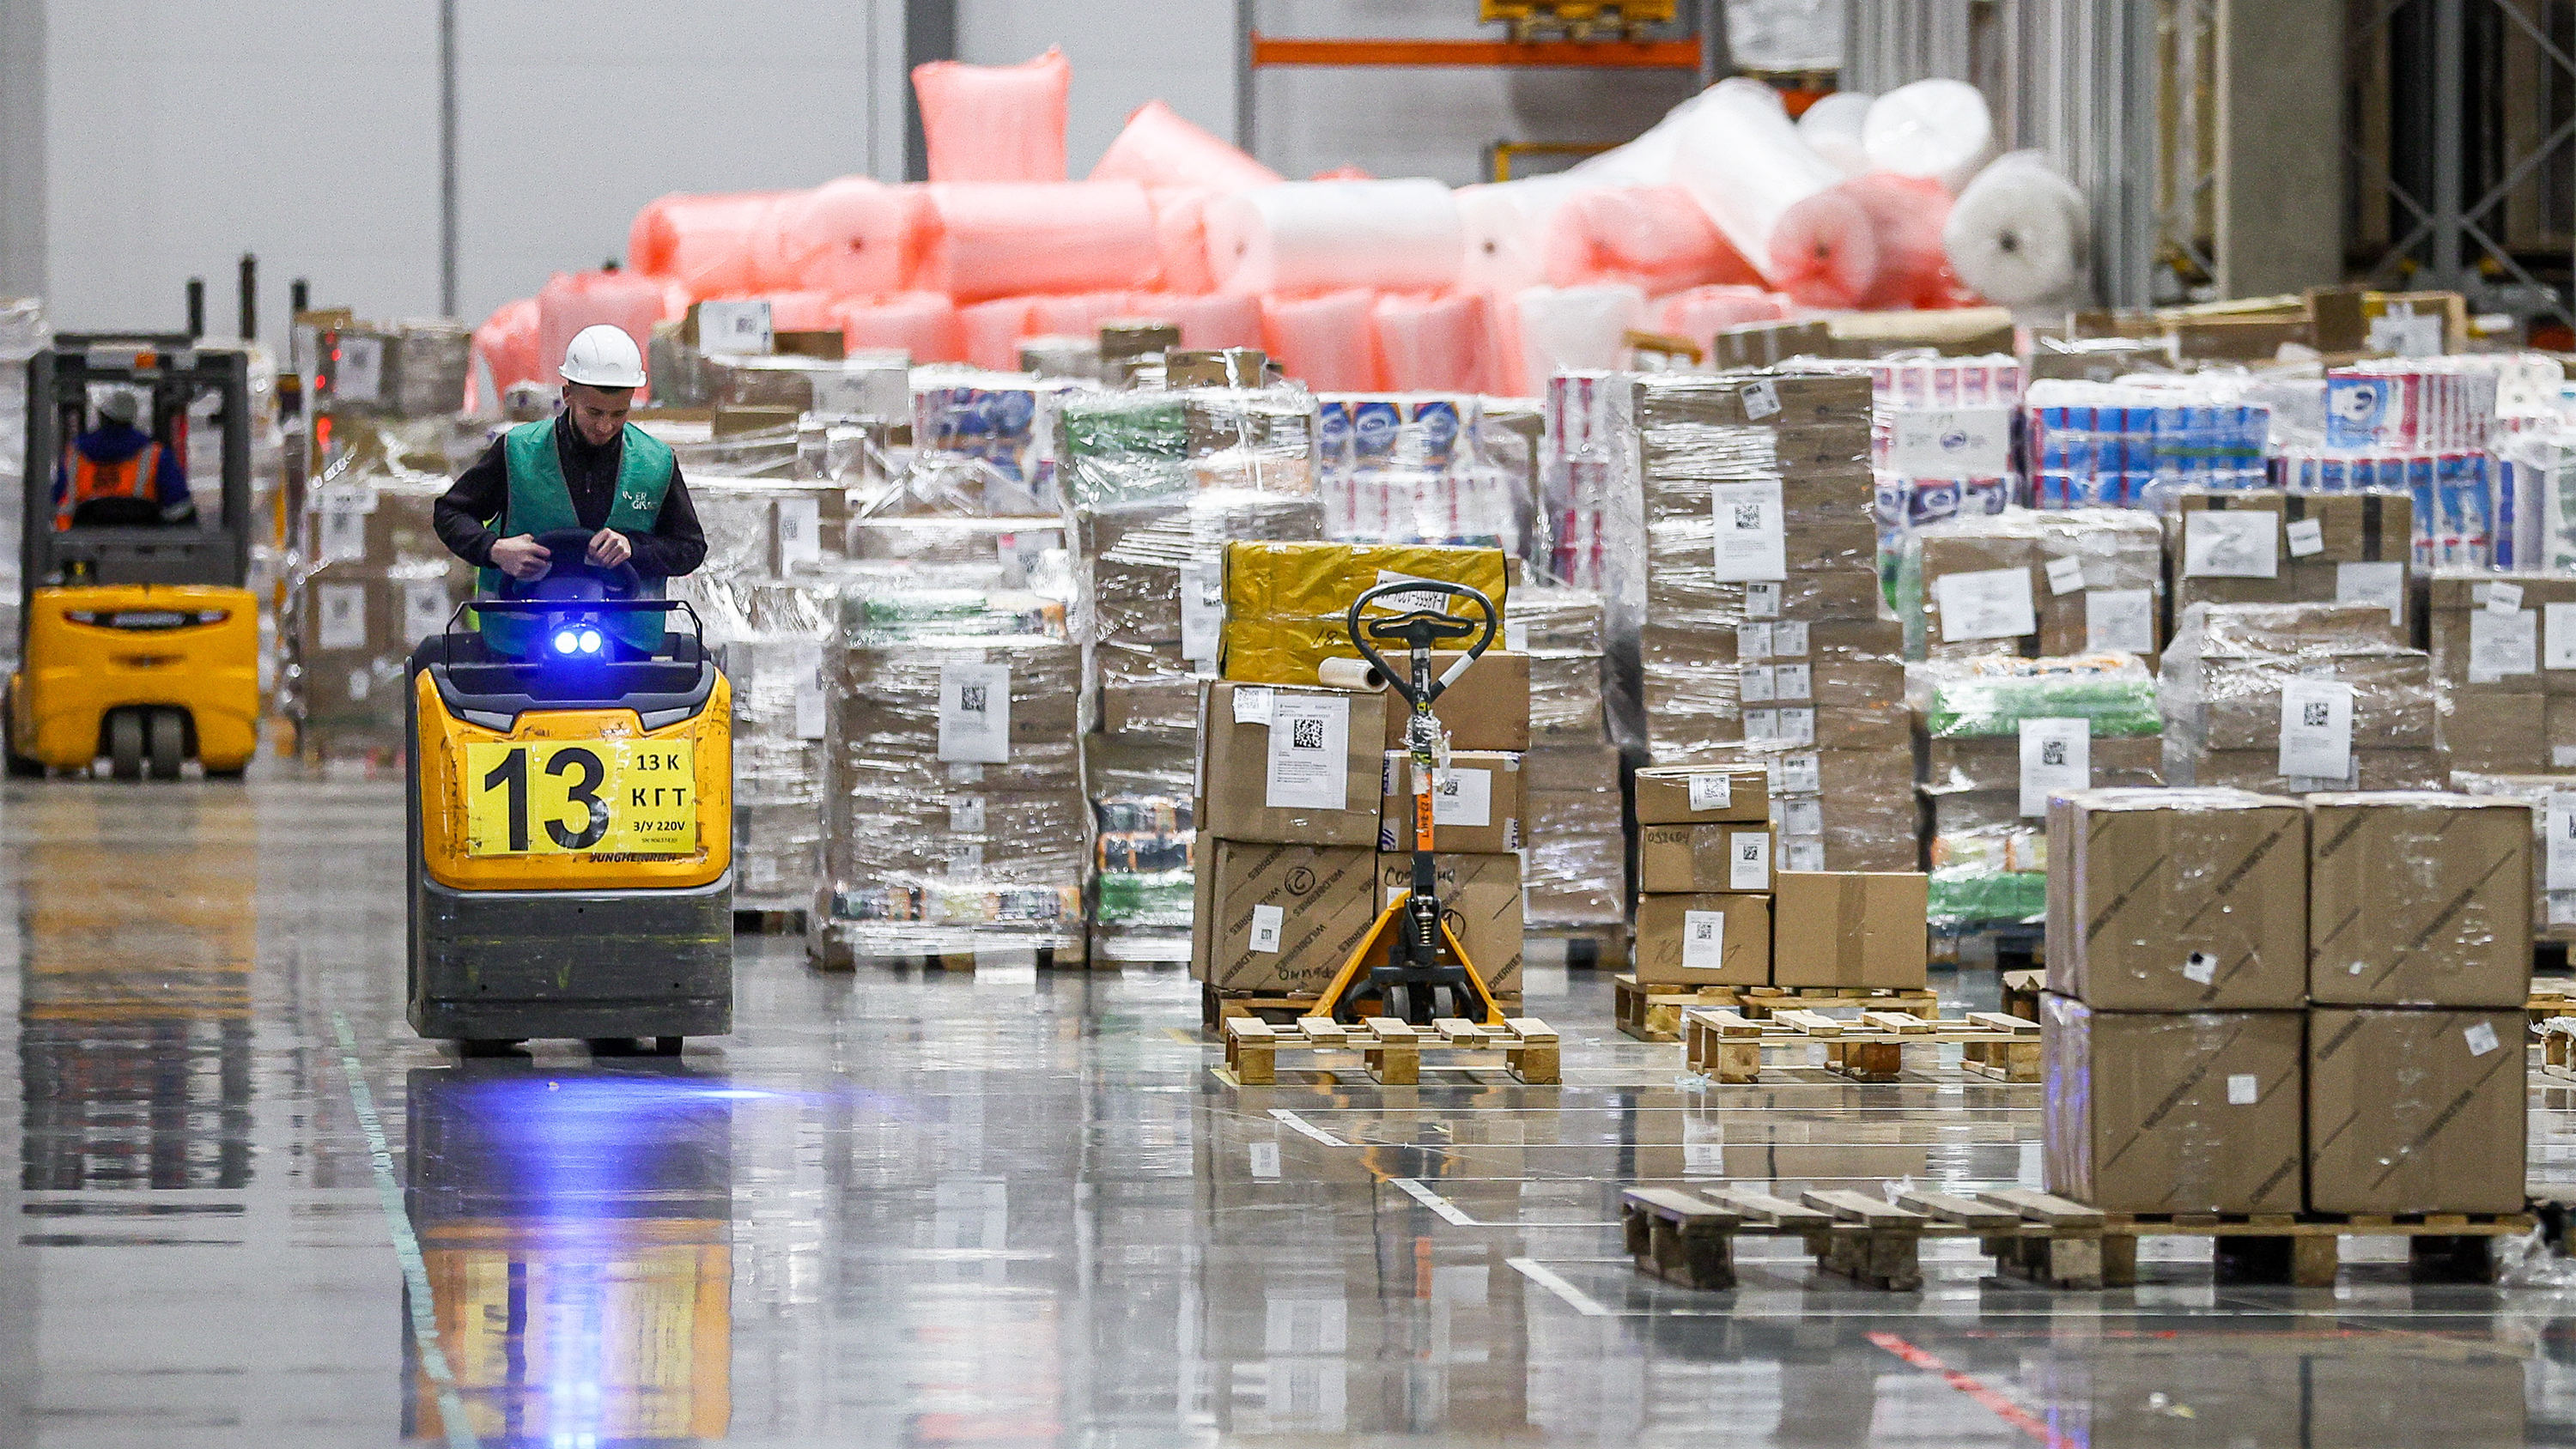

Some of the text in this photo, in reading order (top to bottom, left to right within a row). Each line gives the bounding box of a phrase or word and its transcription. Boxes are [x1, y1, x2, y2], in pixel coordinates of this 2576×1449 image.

[636, 754, 659, 771] 13
[484, 747, 610, 852] 13
[657, 821, 685, 832] 220V
[1292, 869, 1346, 918] WILDBERRIES
